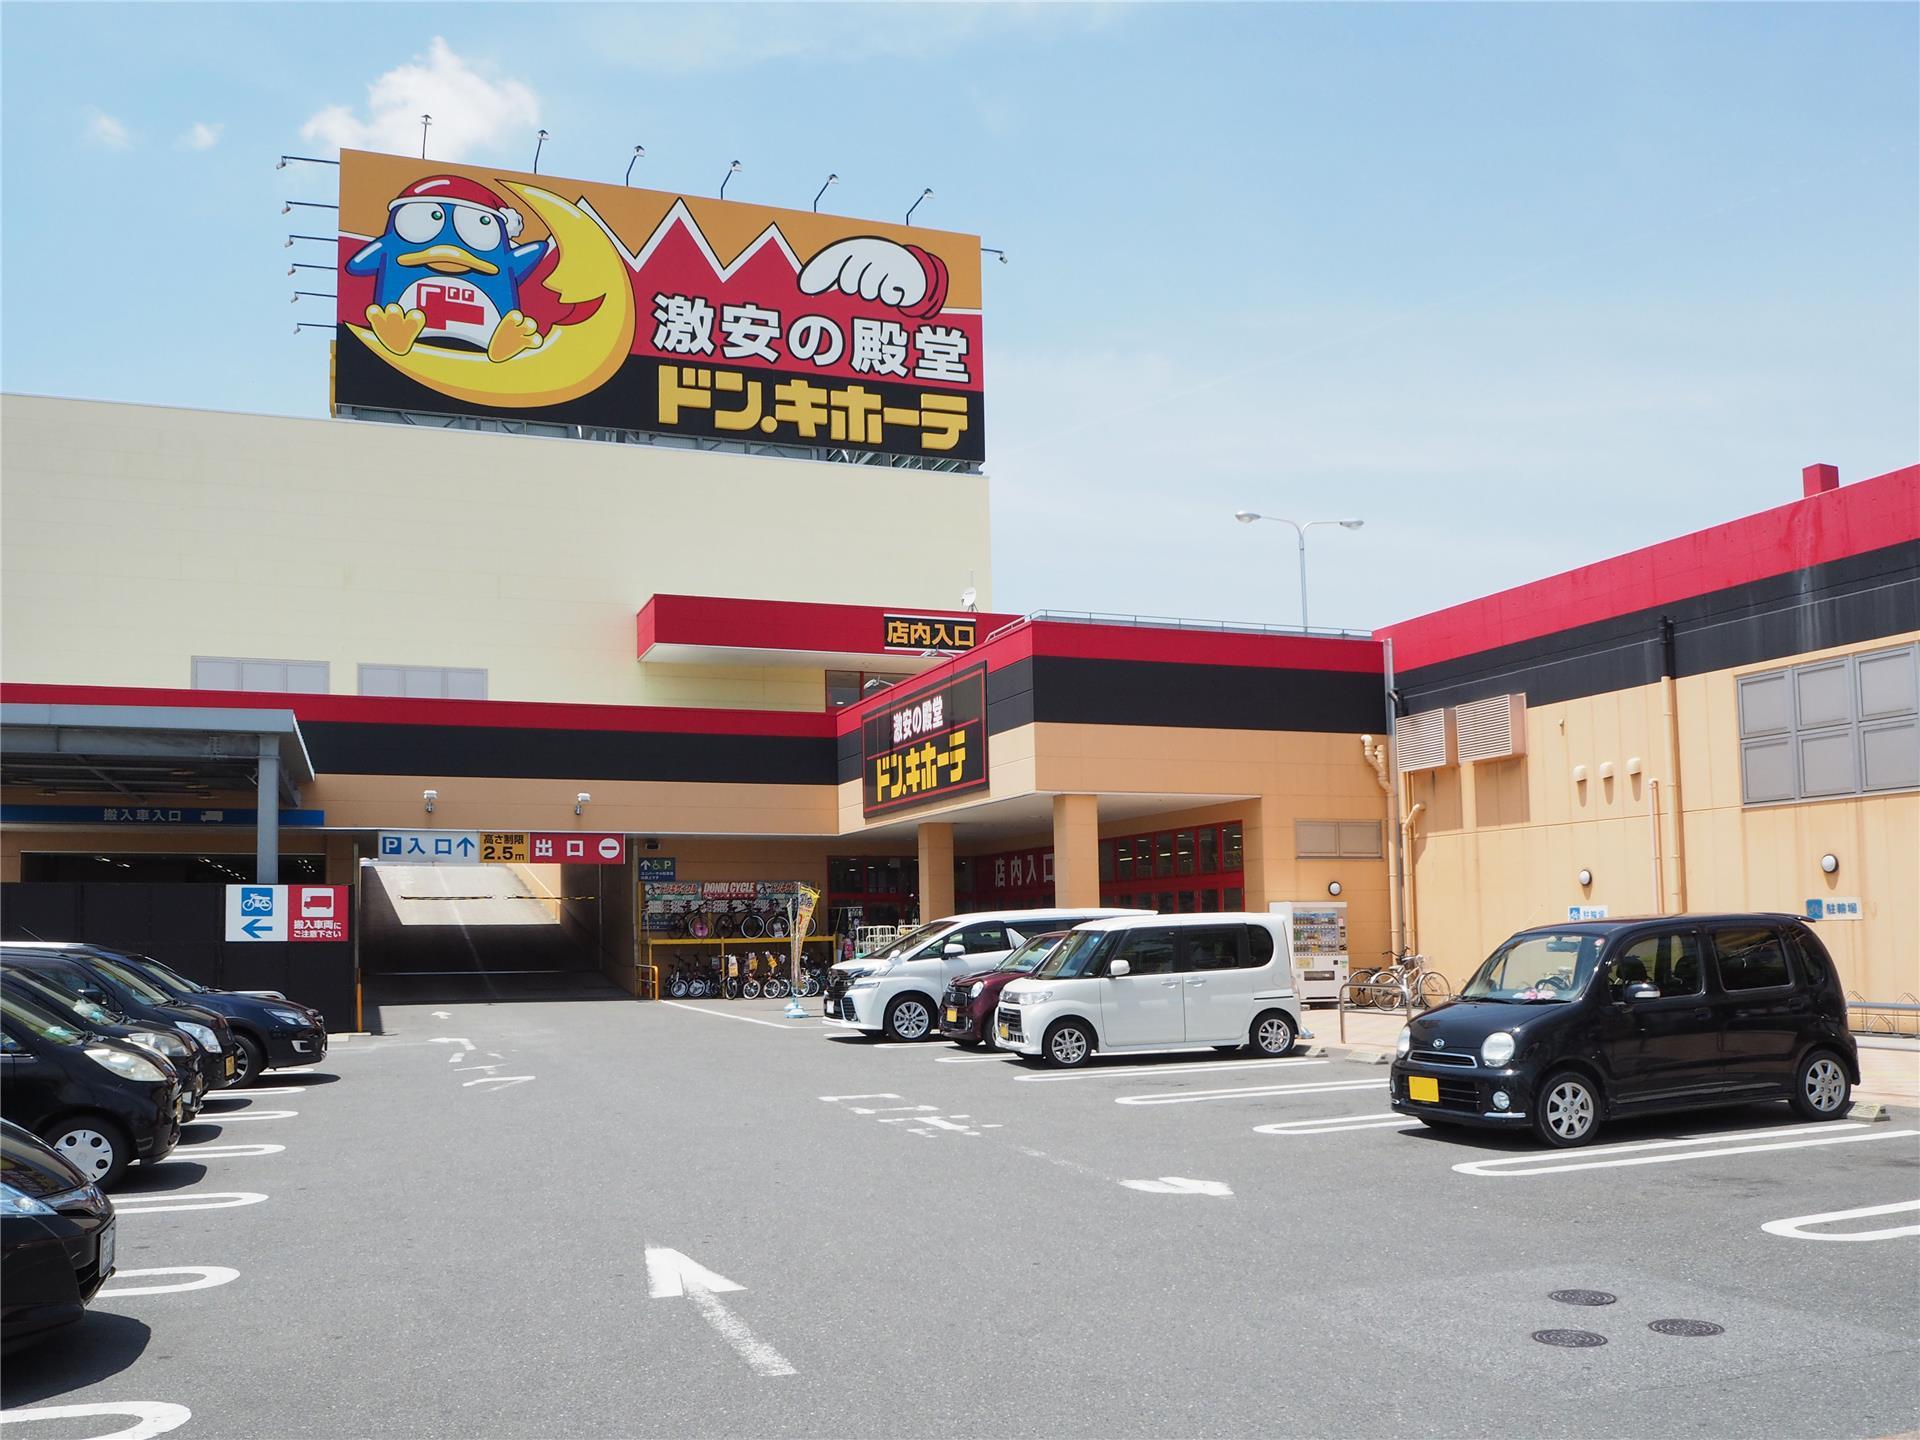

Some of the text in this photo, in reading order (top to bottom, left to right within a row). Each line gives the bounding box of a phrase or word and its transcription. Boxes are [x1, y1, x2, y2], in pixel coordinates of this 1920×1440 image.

[652, 293, 970, 382] 激安の殿堂
[887, 621, 974, 647] 店内入口
[893, 695, 943, 744] 激安の殿堂
[103, 808, 182, 822] 搬入車入口
[407, 838, 452, 855] 入口
[483, 834, 524, 845] 高さ制限
[483, 846, 525, 861] 2.5m
[535, 839, 584, 857] 出口
[995, 854, 1055, 888] 店内入口
[704, 882, 729, 893] DONKI
[730, 882, 755, 893] CYCLE
[293, 919, 342, 929] 搬入車両に
[293, 930, 342, 938] ご注意下さい
